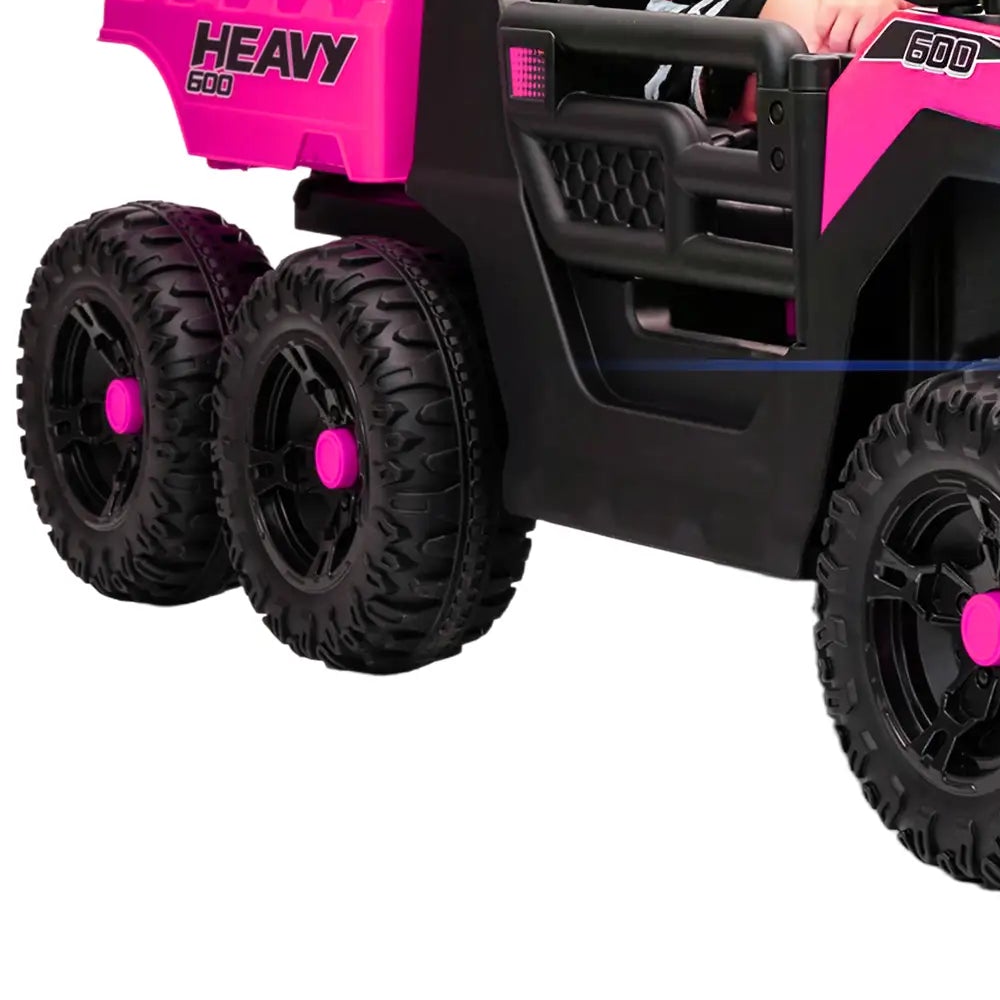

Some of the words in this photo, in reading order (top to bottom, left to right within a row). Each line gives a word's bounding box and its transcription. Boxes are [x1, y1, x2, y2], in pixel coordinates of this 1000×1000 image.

[190, 20, 358, 86] HEAVY
[904, 29, 980, 79] 600
[186, 70, 234, 98] 600
